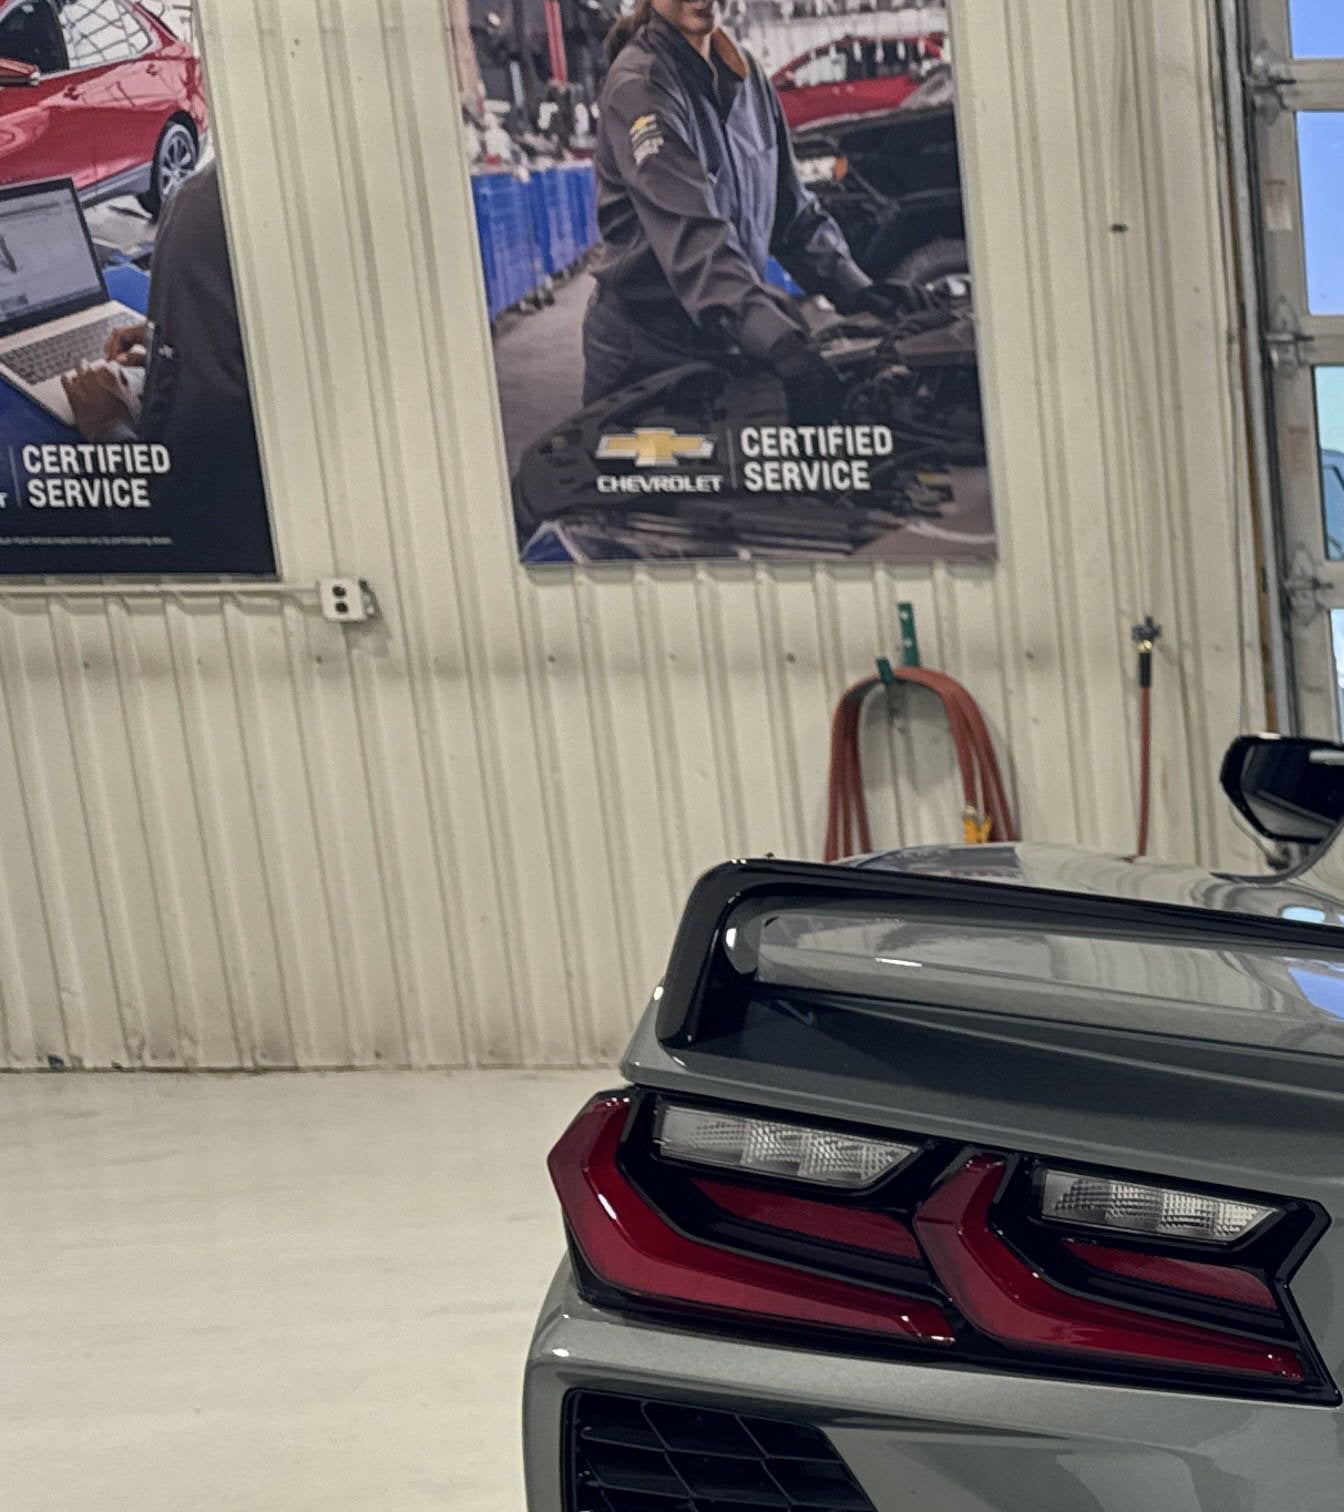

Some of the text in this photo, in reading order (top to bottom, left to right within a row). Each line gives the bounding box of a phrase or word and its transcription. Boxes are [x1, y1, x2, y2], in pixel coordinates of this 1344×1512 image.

[741, 426, 893, 458] CERTIFIED
[22, 444, 171, 474] CERTIFIED
[596, 474, 722, 493] CHEVROLET
[744, 460, 871, 491] SERVICE
[28, 478, 150, 508] SERVICE
